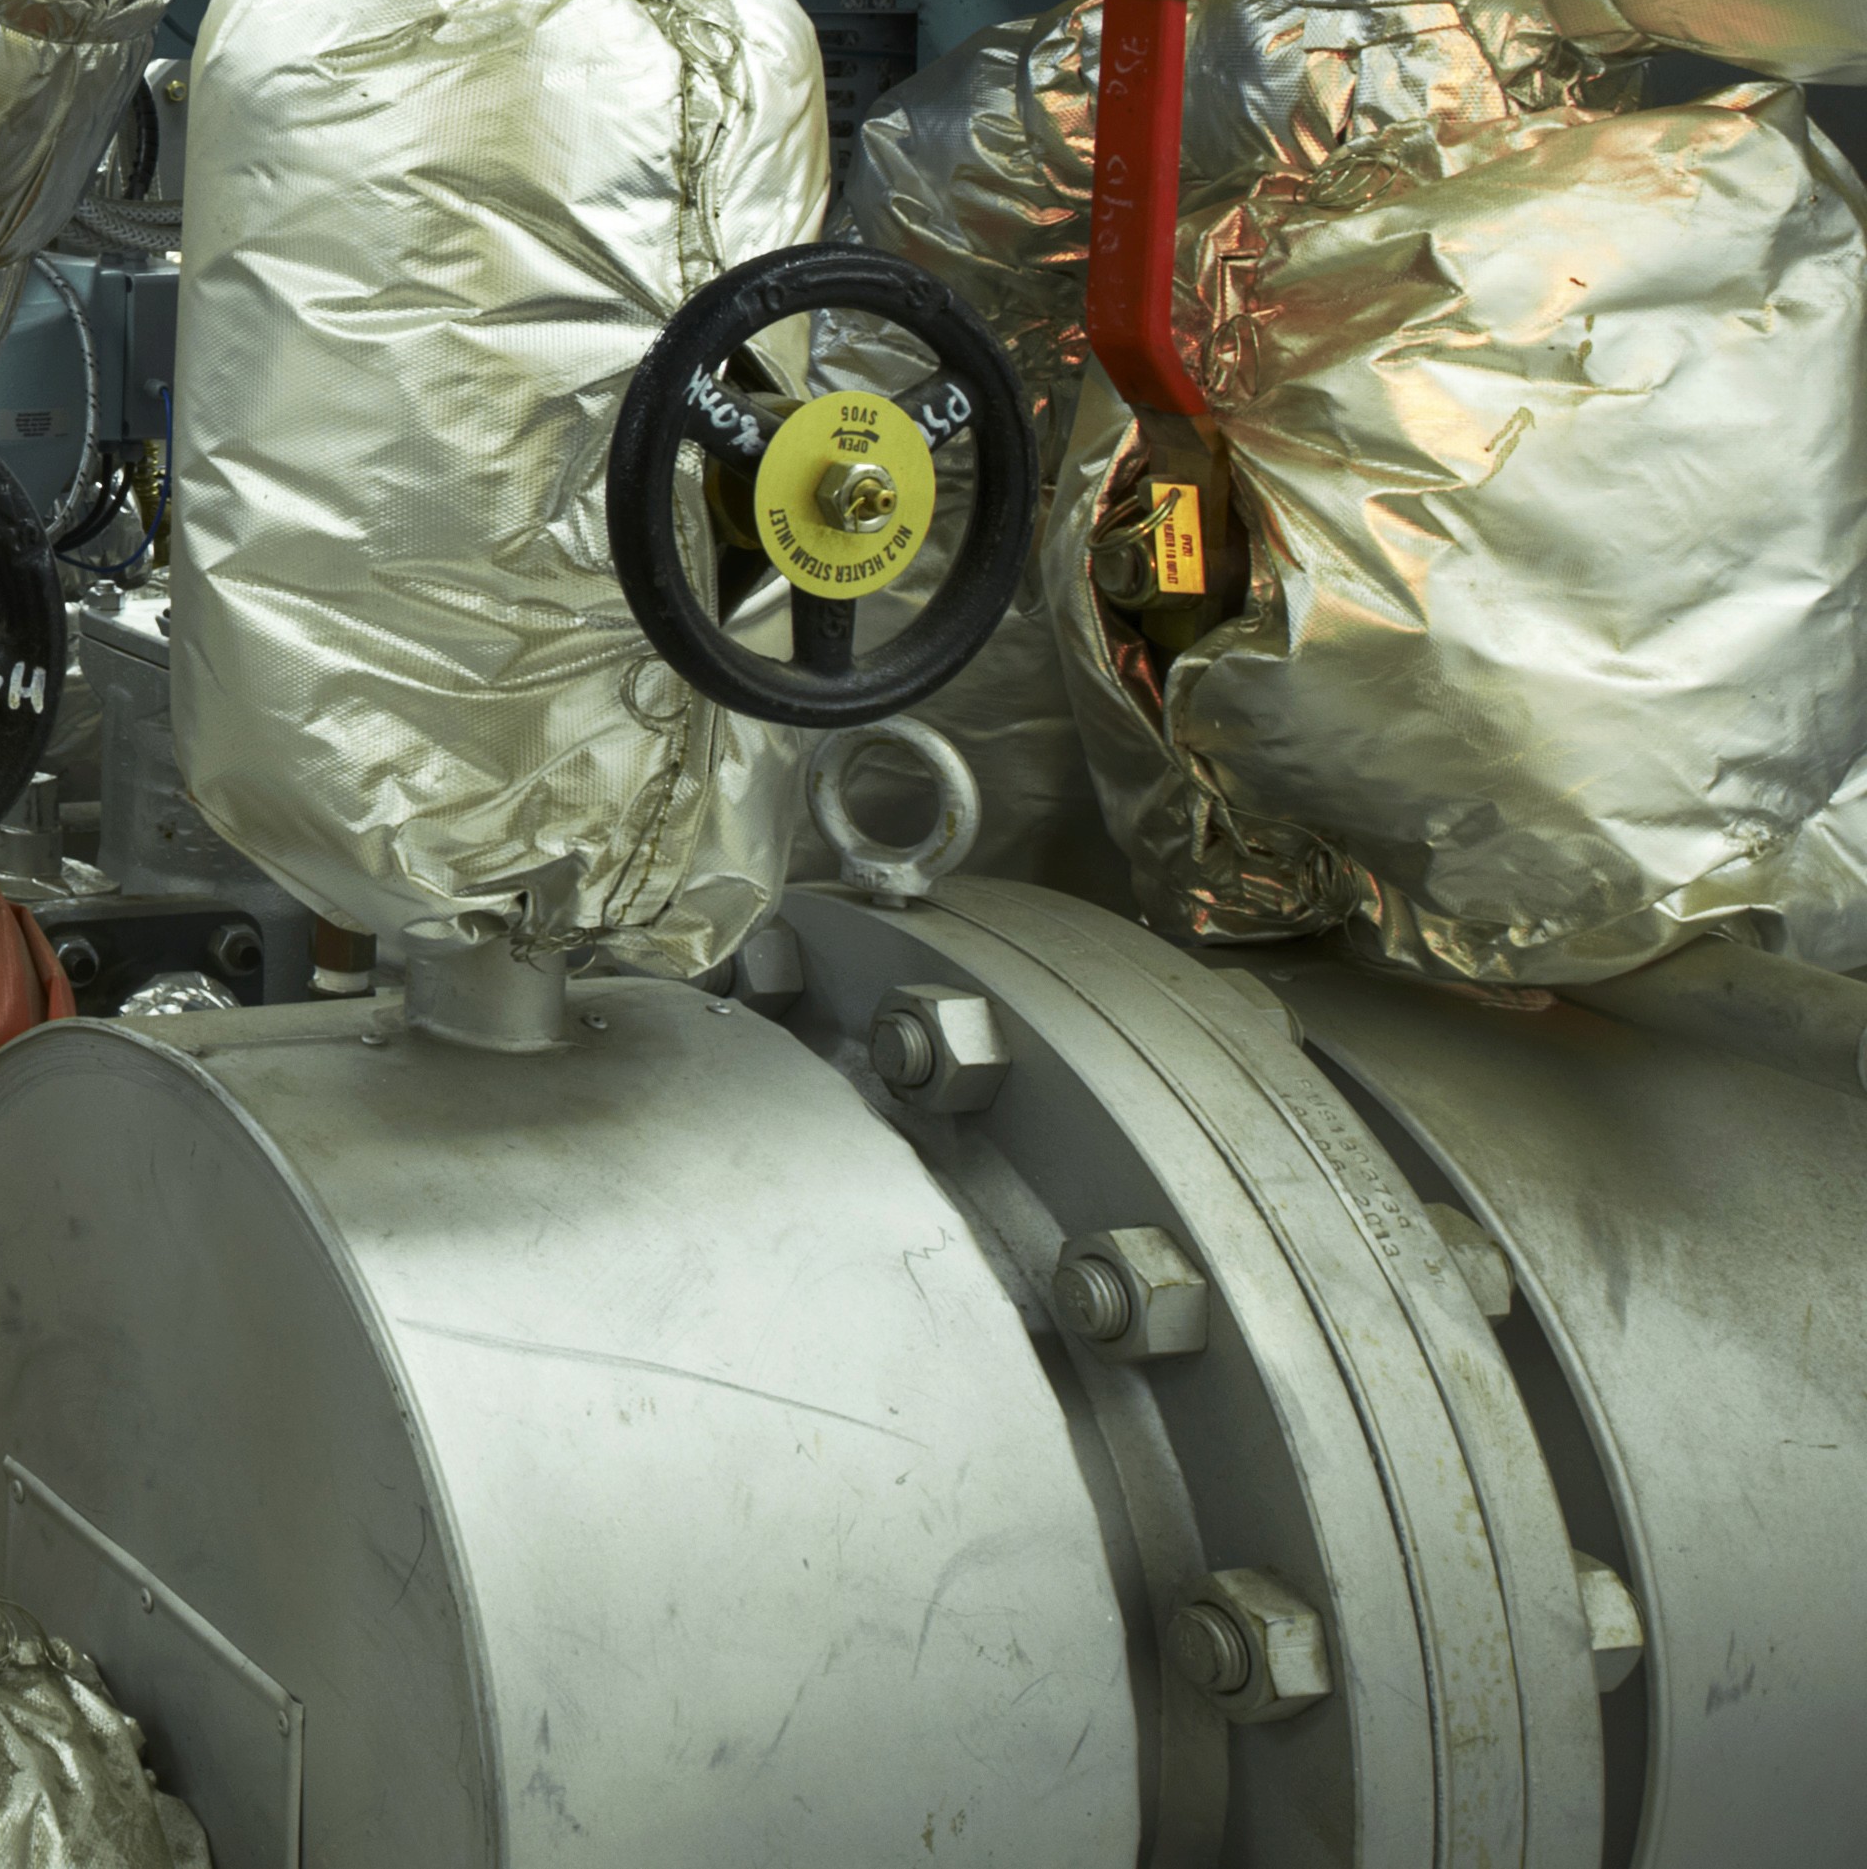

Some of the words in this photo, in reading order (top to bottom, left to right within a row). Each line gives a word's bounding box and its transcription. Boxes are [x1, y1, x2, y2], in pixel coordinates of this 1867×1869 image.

[838, 437, 869, 453] OPEN
[769, 508, 796, 551] INLET
[883, 524, 913, 562] NO.2
[790, 545, 832, 582] STEAM
[836, 554, 886, 583] HEATER
